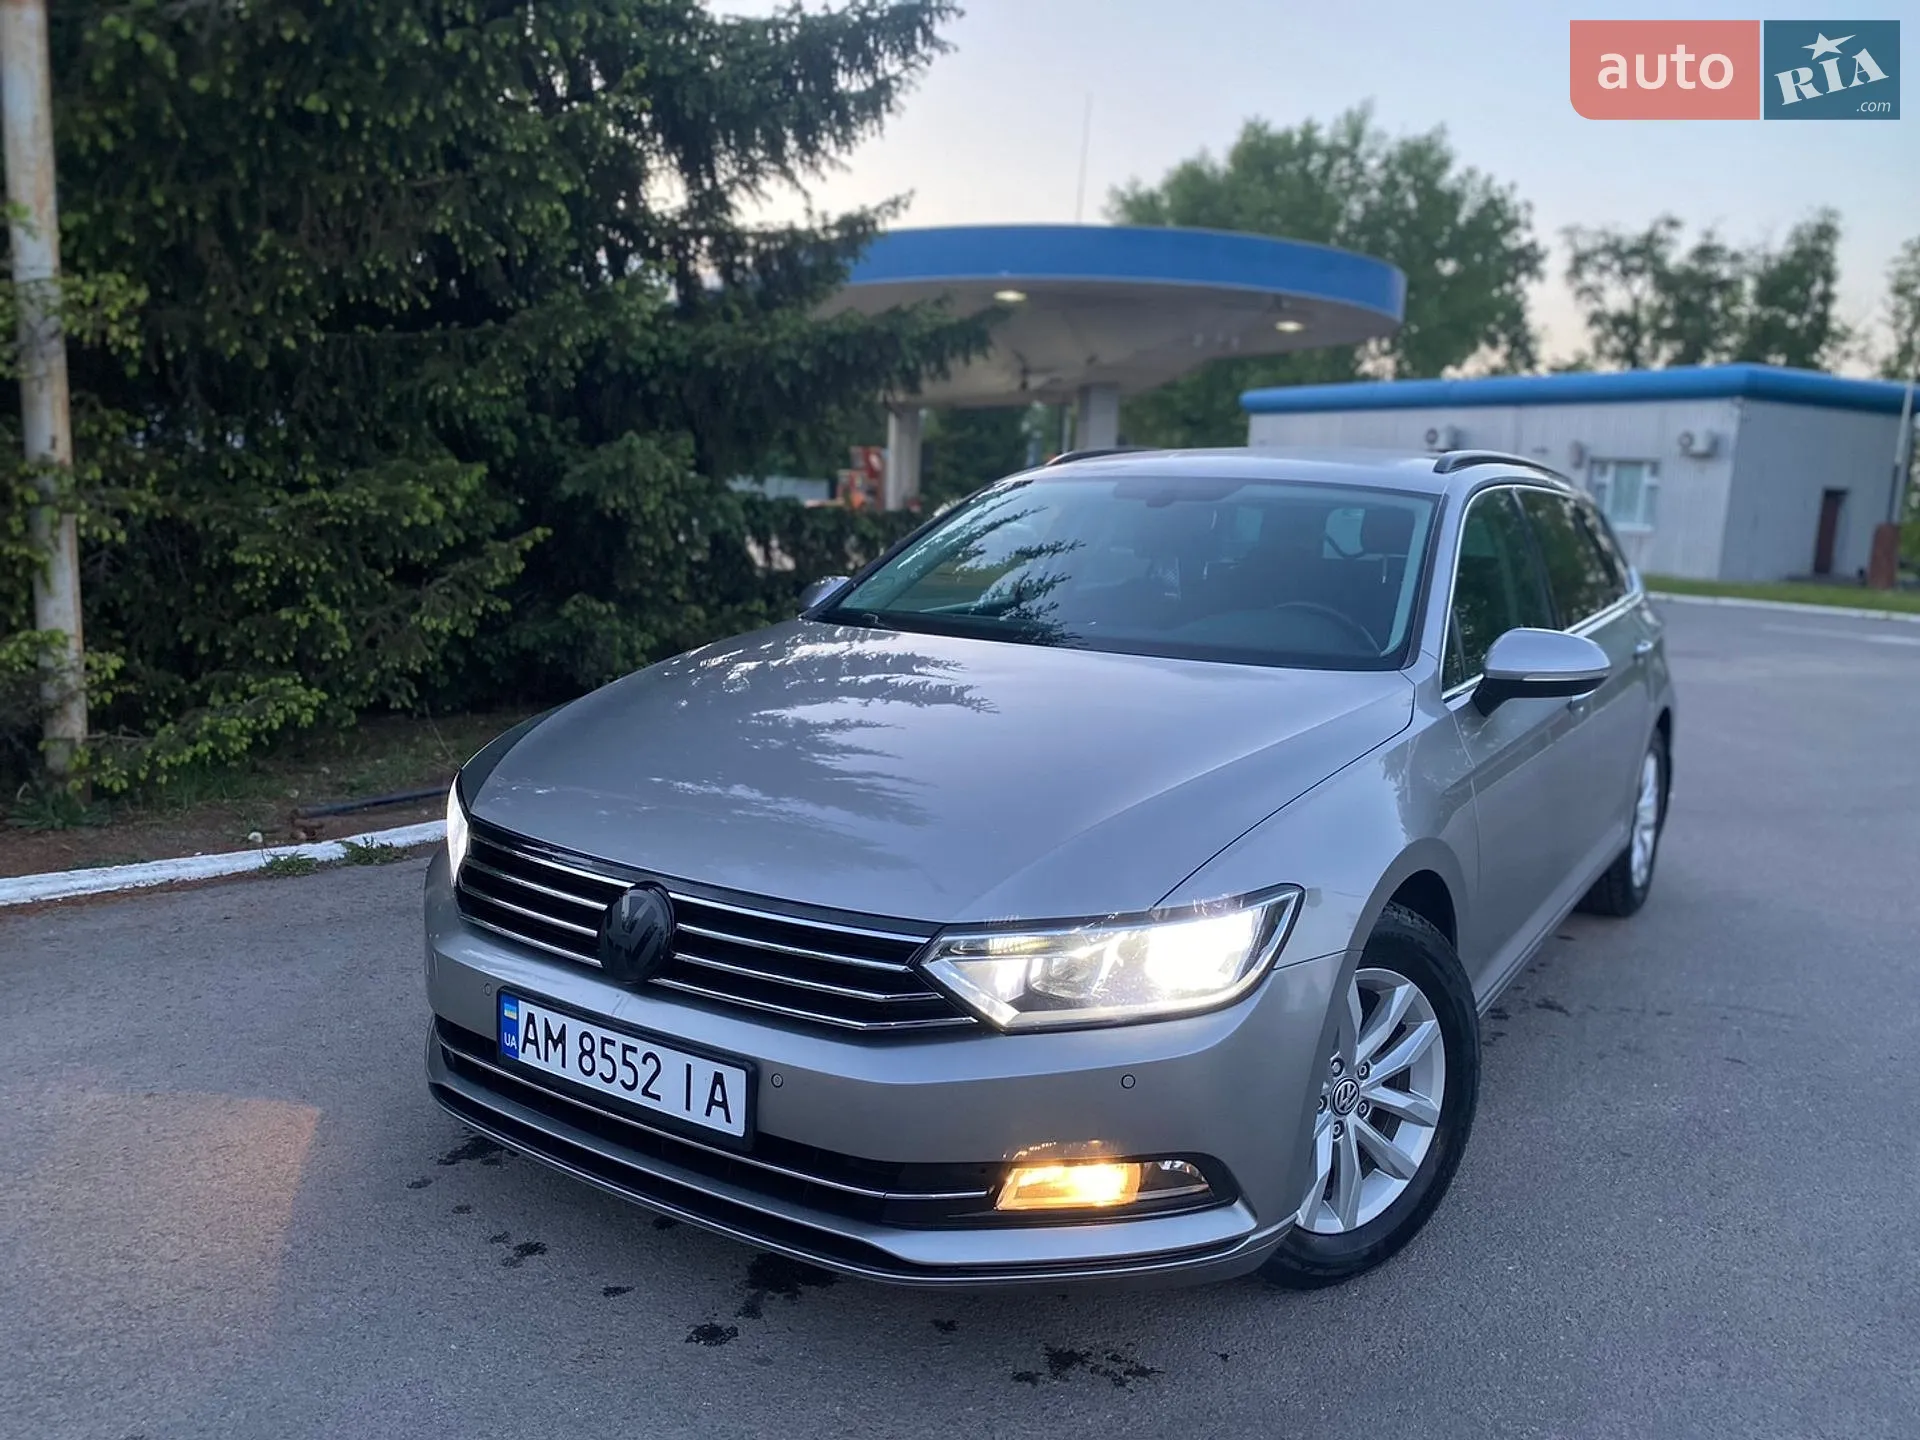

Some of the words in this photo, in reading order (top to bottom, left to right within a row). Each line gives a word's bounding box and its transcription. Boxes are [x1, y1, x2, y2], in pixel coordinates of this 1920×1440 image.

[503, 1032, 518, 1051] UA
[521, 1011, 567, 1069] AM
[578, 1030, 662, 1102] 8552
[685, 1062, 732, 1124] IA
